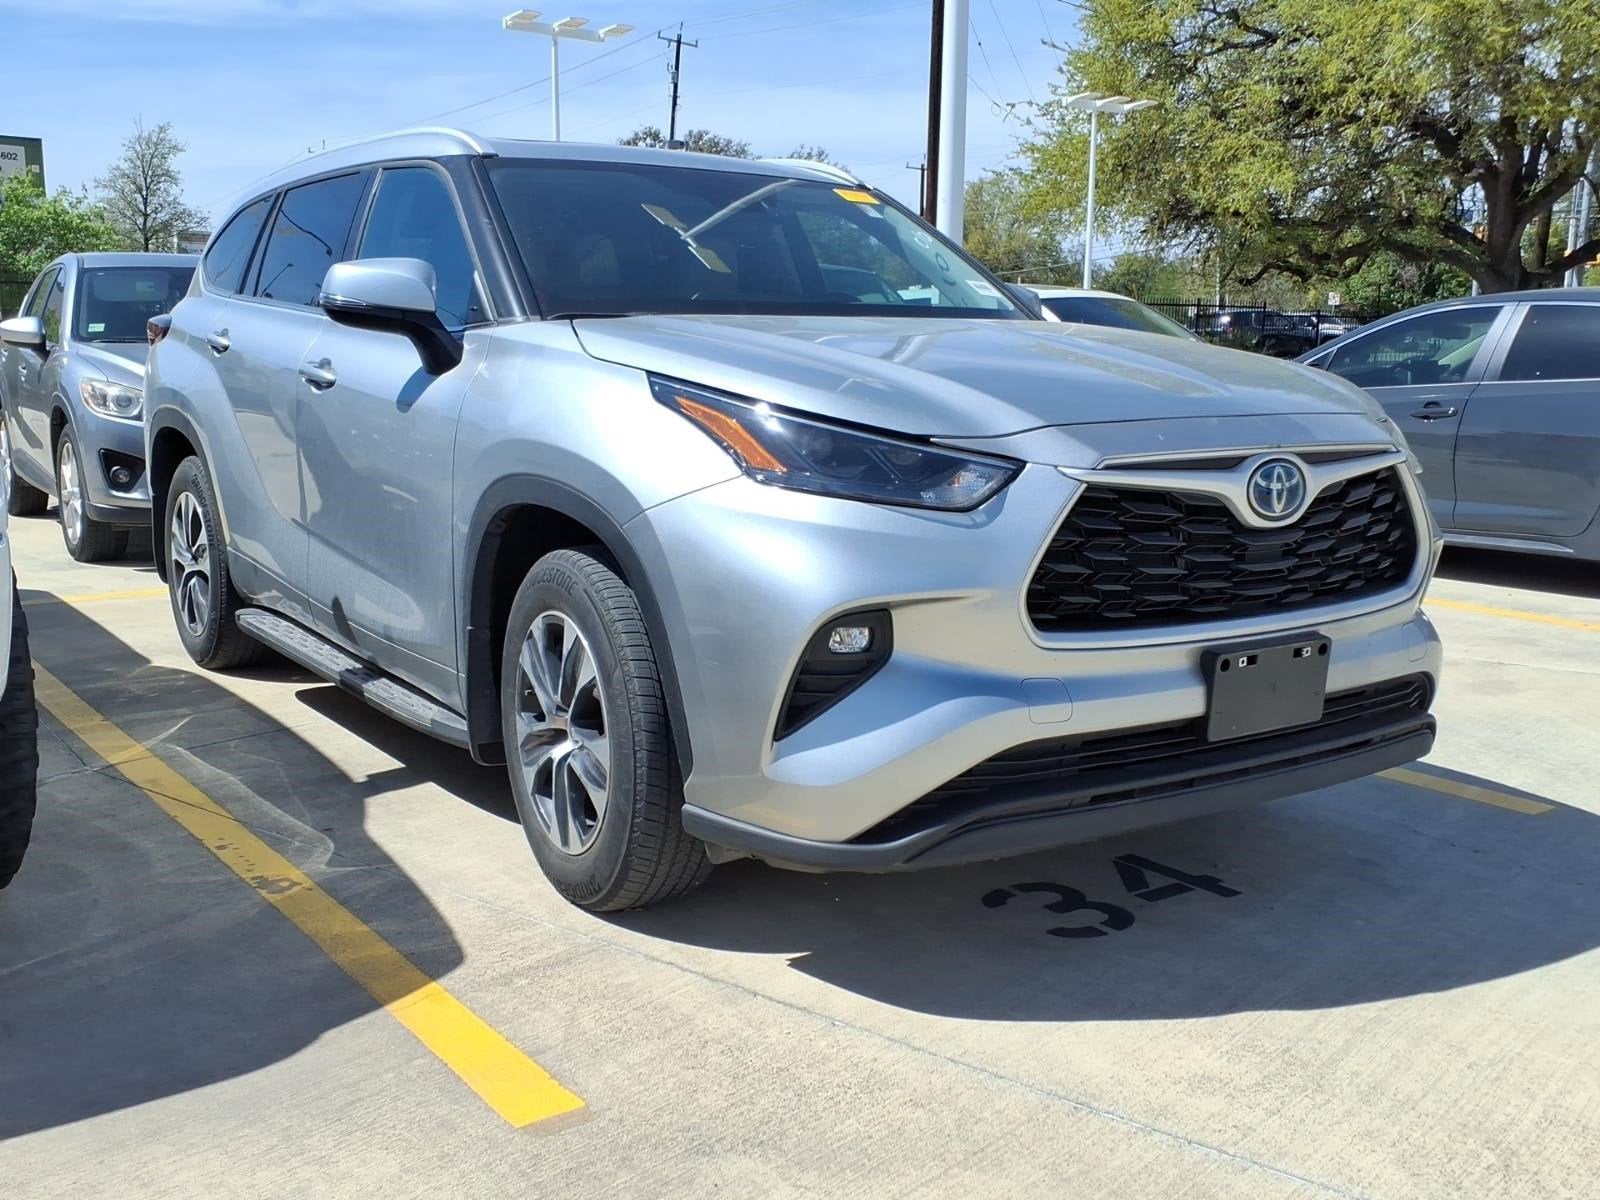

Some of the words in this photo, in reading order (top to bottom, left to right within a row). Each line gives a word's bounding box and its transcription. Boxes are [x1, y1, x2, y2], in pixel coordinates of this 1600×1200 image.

[191, 473, 214, 549] BRIDGESTONE
[525, 567, 579, 596] IDGESTONE
[981, 853, 1243, 939] 34
